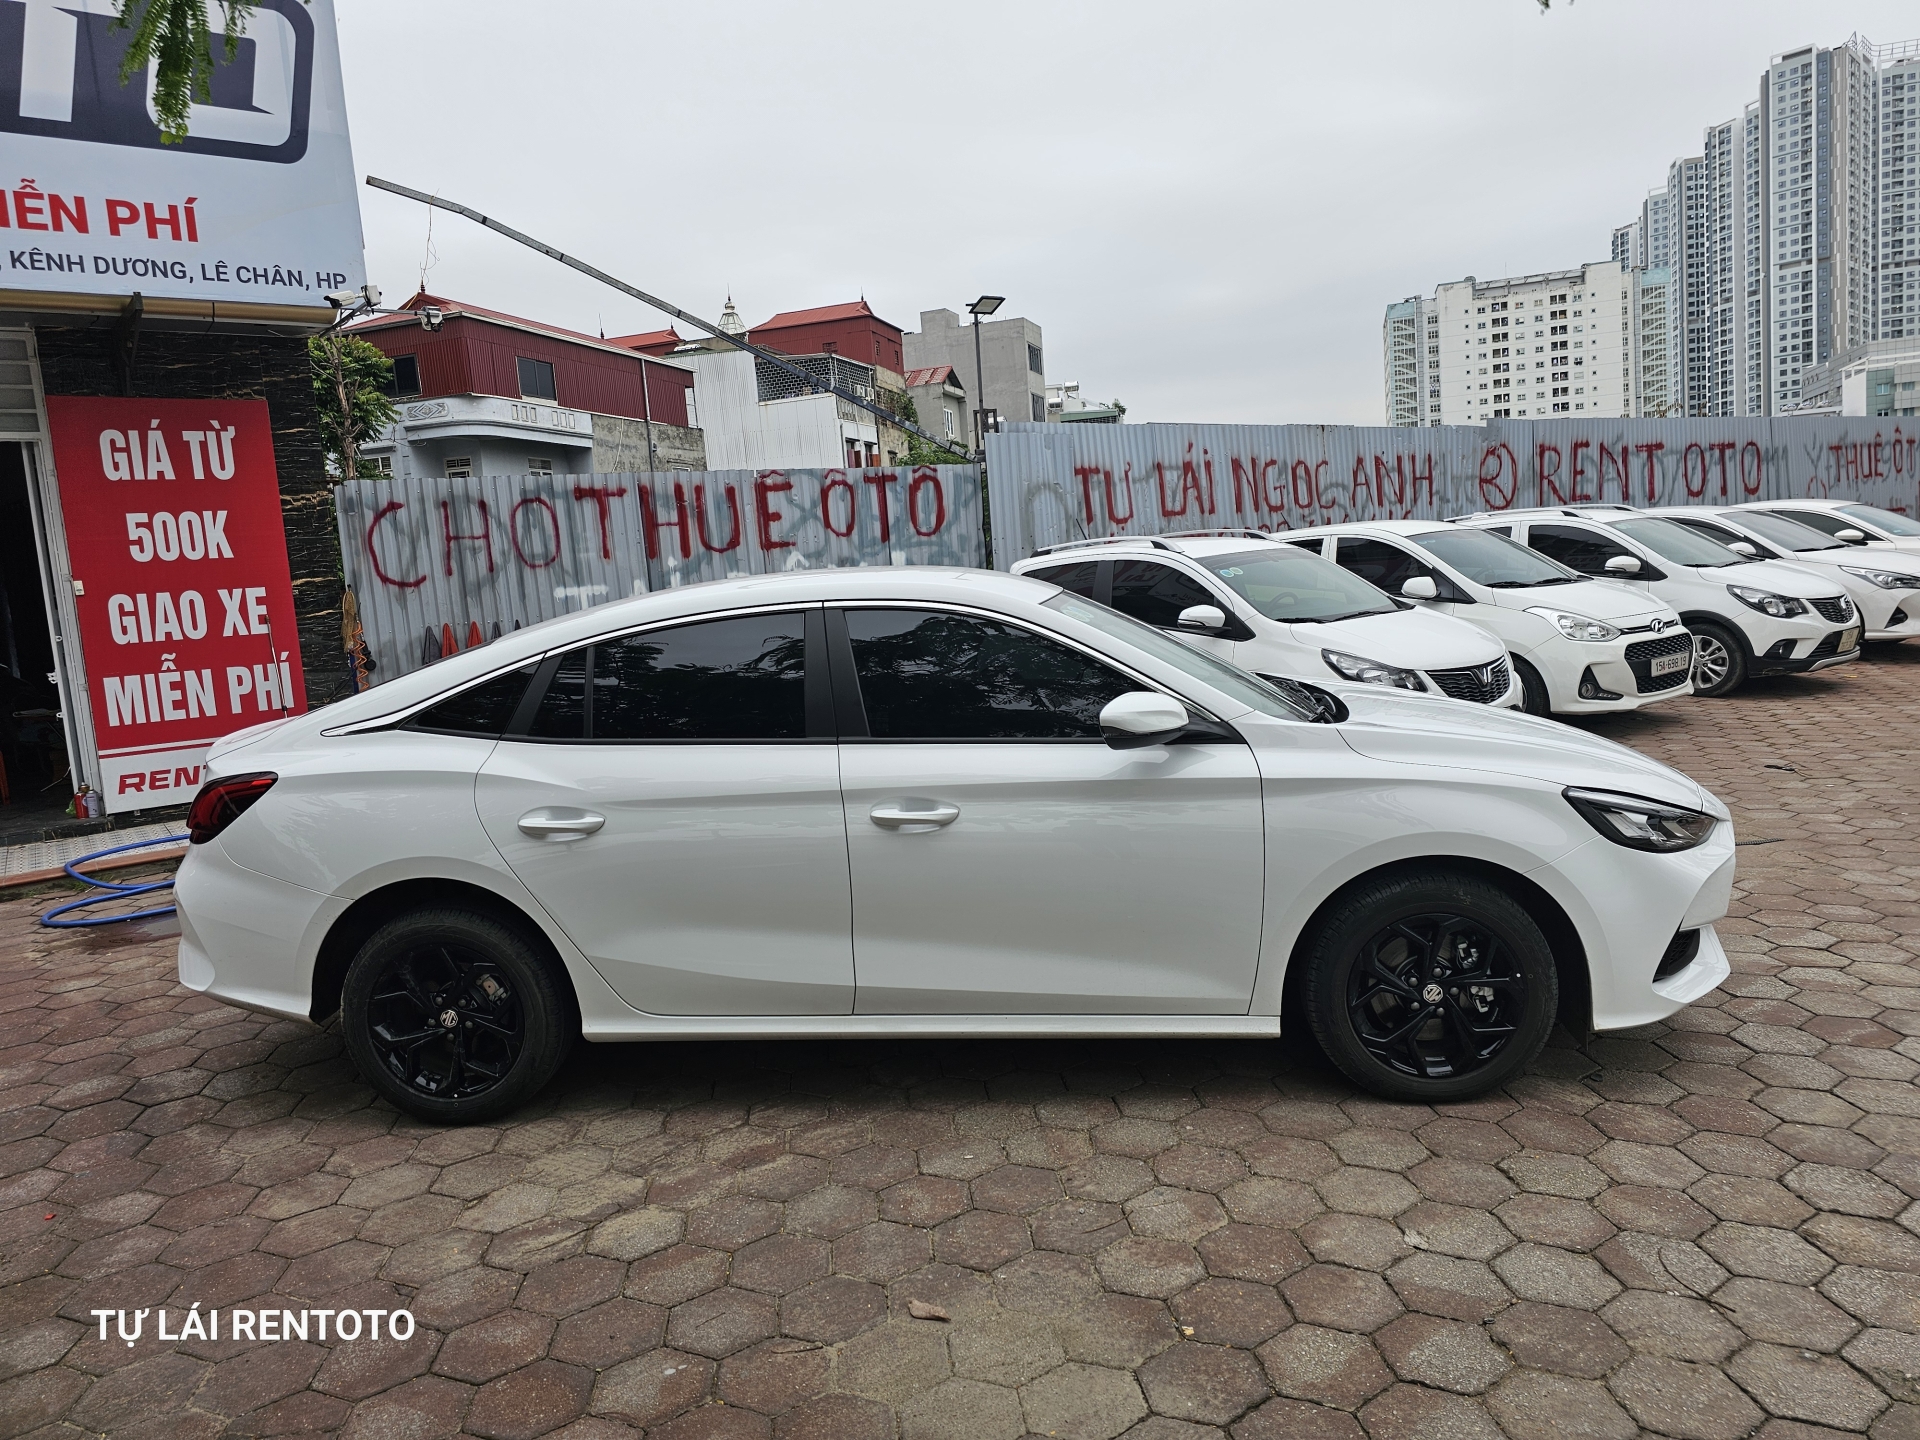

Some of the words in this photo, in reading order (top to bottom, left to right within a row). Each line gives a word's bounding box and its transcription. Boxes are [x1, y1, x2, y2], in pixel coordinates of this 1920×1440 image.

[0, 178, 90, 234] IỄN
[105, 197, 199, 243] PHÍ
[9, 247, 86, 274] KÊNH
[93, 255, 194, 283] DƯƠNG,
[201, 260, 229, 283] LÊ
[236, 264, 311, 291] CHÂN,
[316, 271, 347, 290] HP
[99, 418, 176, 482] GIÁ
[183, 420, 236, 480] TỪ
[1828, 431, 1884, 484] THUÊ
[1892, 425, 1920, 474] ÔT
[1074, 461, 1134, 532] TỰ
[1352, 453, 1434, 508] ANH
[125, 510, 235, 562] 500K
[367, 496, 560, 588] CHO
[573, 470, 797, 561] THUÊ
[821, 465, 945, 542] ÔTÔ
[107, 590, 208, 646] GIAO
[217, 586, 270, 637] XE
[103, 652, 217, 727] MIỄN
[226, 651, 296, 715] PHÍ
[118, 765, 206, 795] REN
